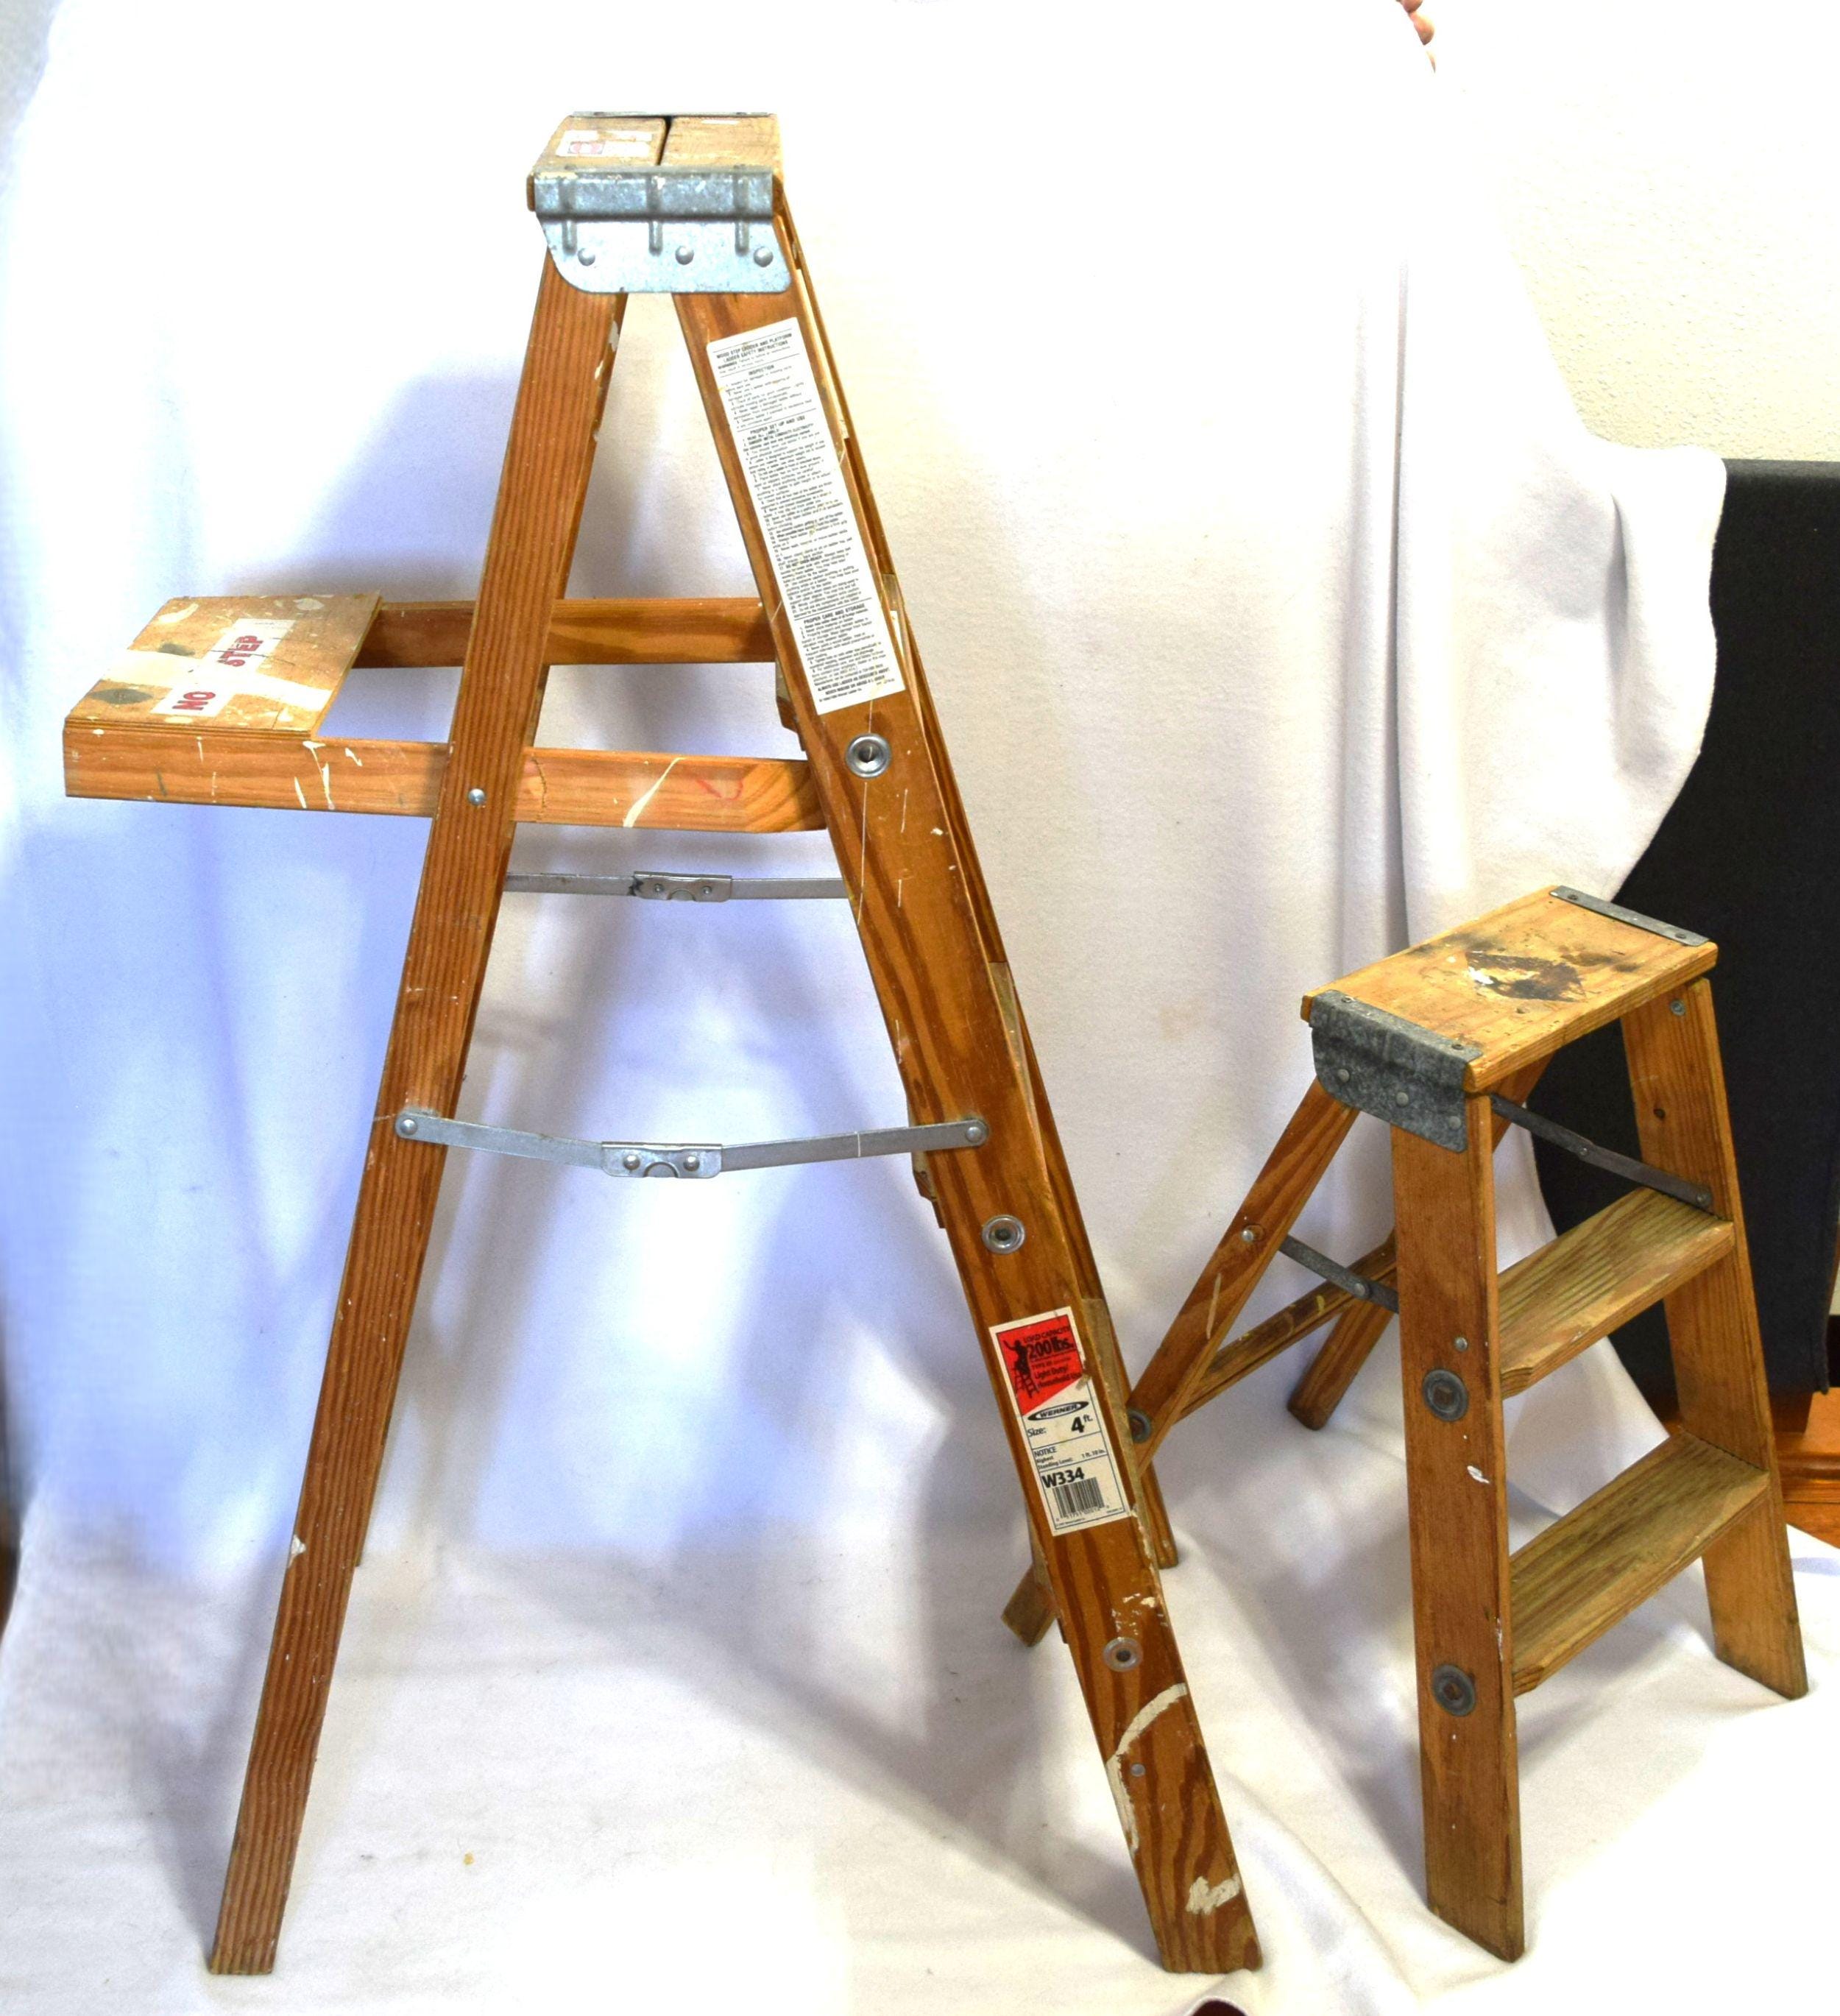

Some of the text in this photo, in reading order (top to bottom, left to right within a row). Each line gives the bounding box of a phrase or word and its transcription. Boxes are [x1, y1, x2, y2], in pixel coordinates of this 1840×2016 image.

[171, 635, 263, 710] NO STEP
[1026, 1340, 1053, 1359] 200
[1040, 1404, 1077, 1418] WERNER
[1026, 1412, 1093, 1437] Size: 4 ft.
[1033, 1446, 1056, 1457] NOTICE
[1041, 1465, 1085, 1489] W334
